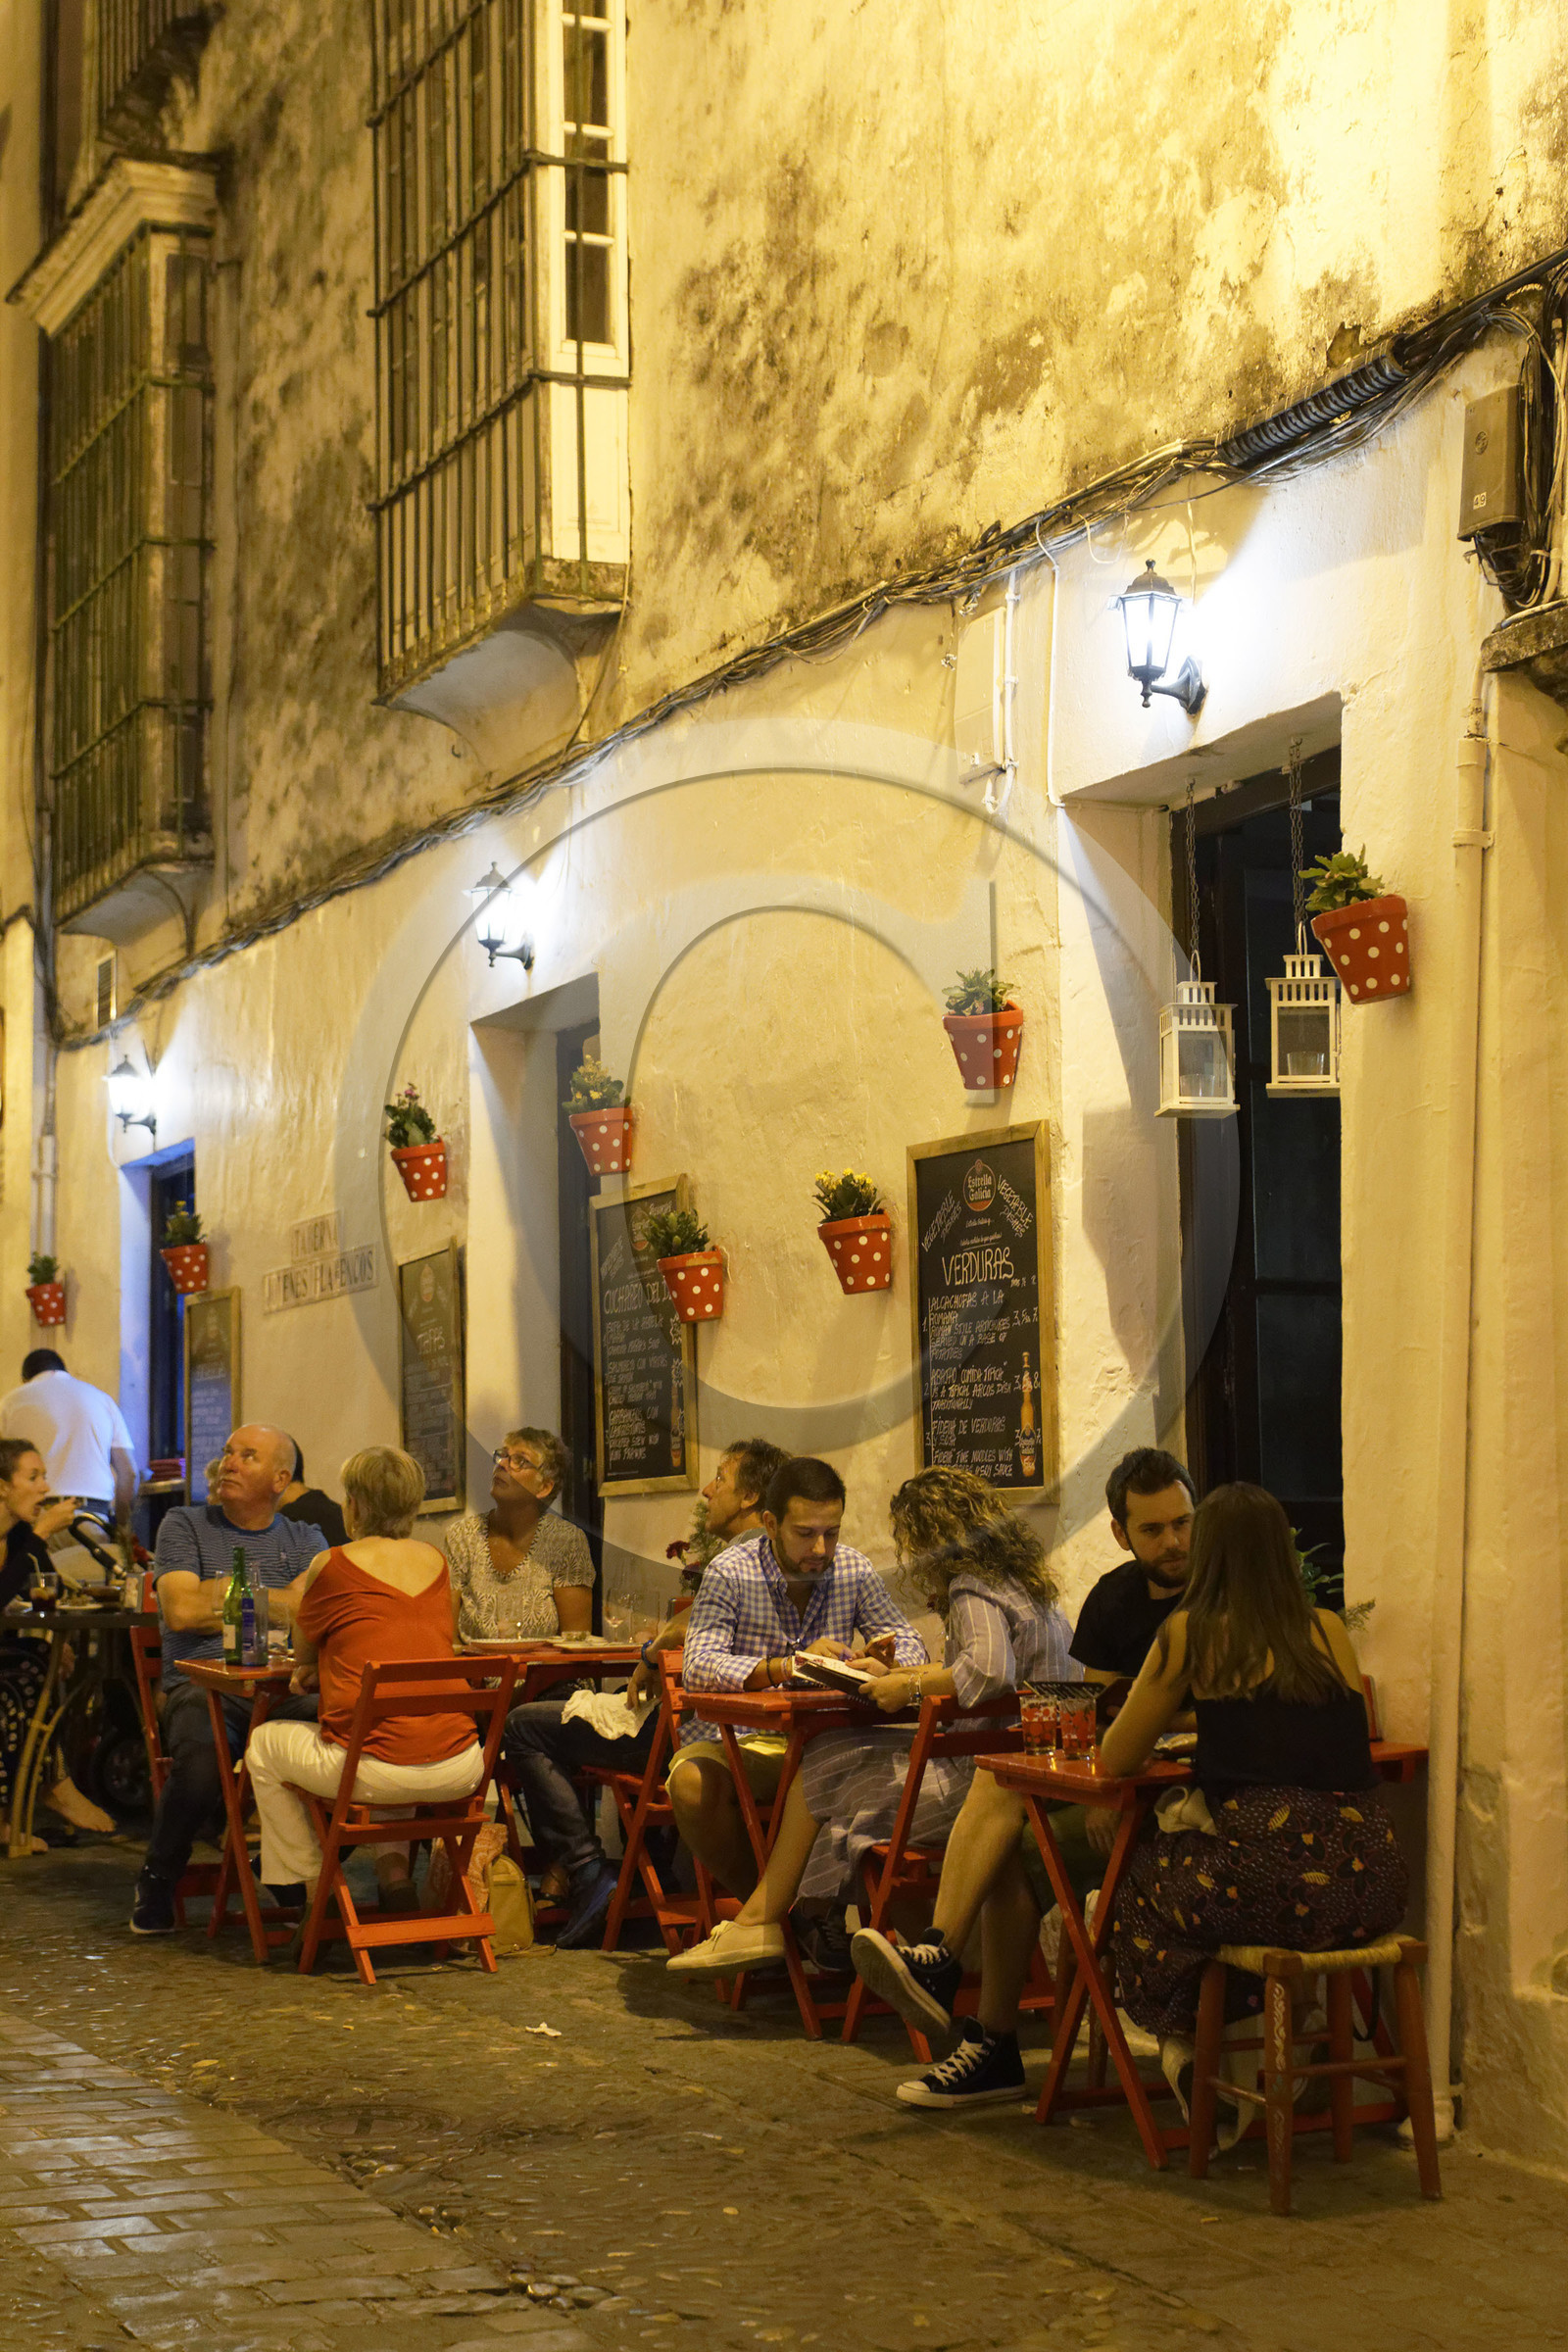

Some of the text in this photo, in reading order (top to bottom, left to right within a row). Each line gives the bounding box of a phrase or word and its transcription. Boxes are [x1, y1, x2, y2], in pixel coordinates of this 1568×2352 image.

[1474, 493, 1486, 508] 49
[967, 1174, 993, 1189] Estrella
[968, 1186, 992, 1201] Galicia
[998, 1174, 1034, 1230] VEGETABLE
[942, 1247, 1014, 1286] VERDURAS
[930, 1292, 978, 1312] ALCACHOFAS
[981, 1293, 989, 1305] A
[993, 1289, 1005, 1304] LA
[957, 1419, 968, 1436] DE
